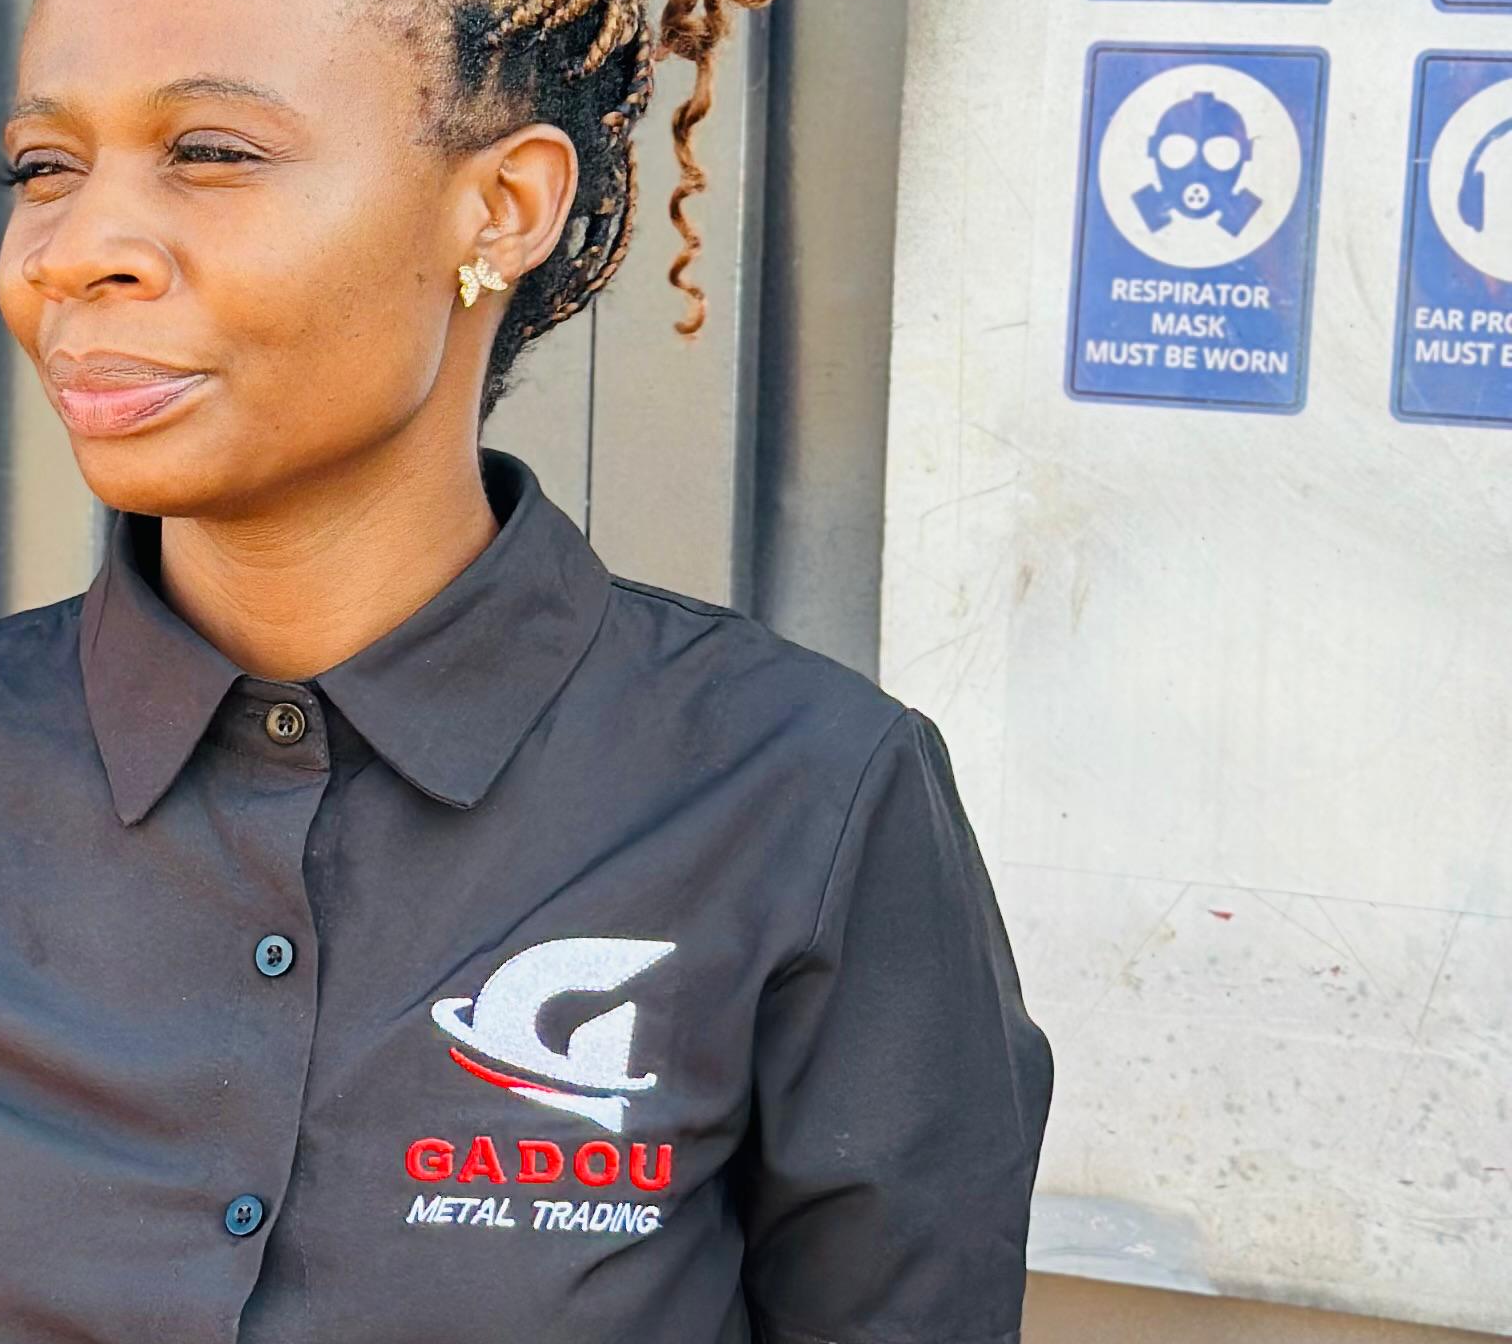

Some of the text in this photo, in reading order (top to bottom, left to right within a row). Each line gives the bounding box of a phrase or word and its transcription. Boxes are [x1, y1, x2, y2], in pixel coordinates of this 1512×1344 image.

[1111, 278, 1271, 309] RESPIRATOR
[1150, 312, 1227, 338] MASK
[1415, 307, 1465, 332] EAR
[1085, 340, 1289, 375] MUST BE WORN
[1415, 339, 1495, 366] MUST
[405, 1136, 673, 1191] GADOU
[406, 1195, 663, 1234] METAL TRADING
